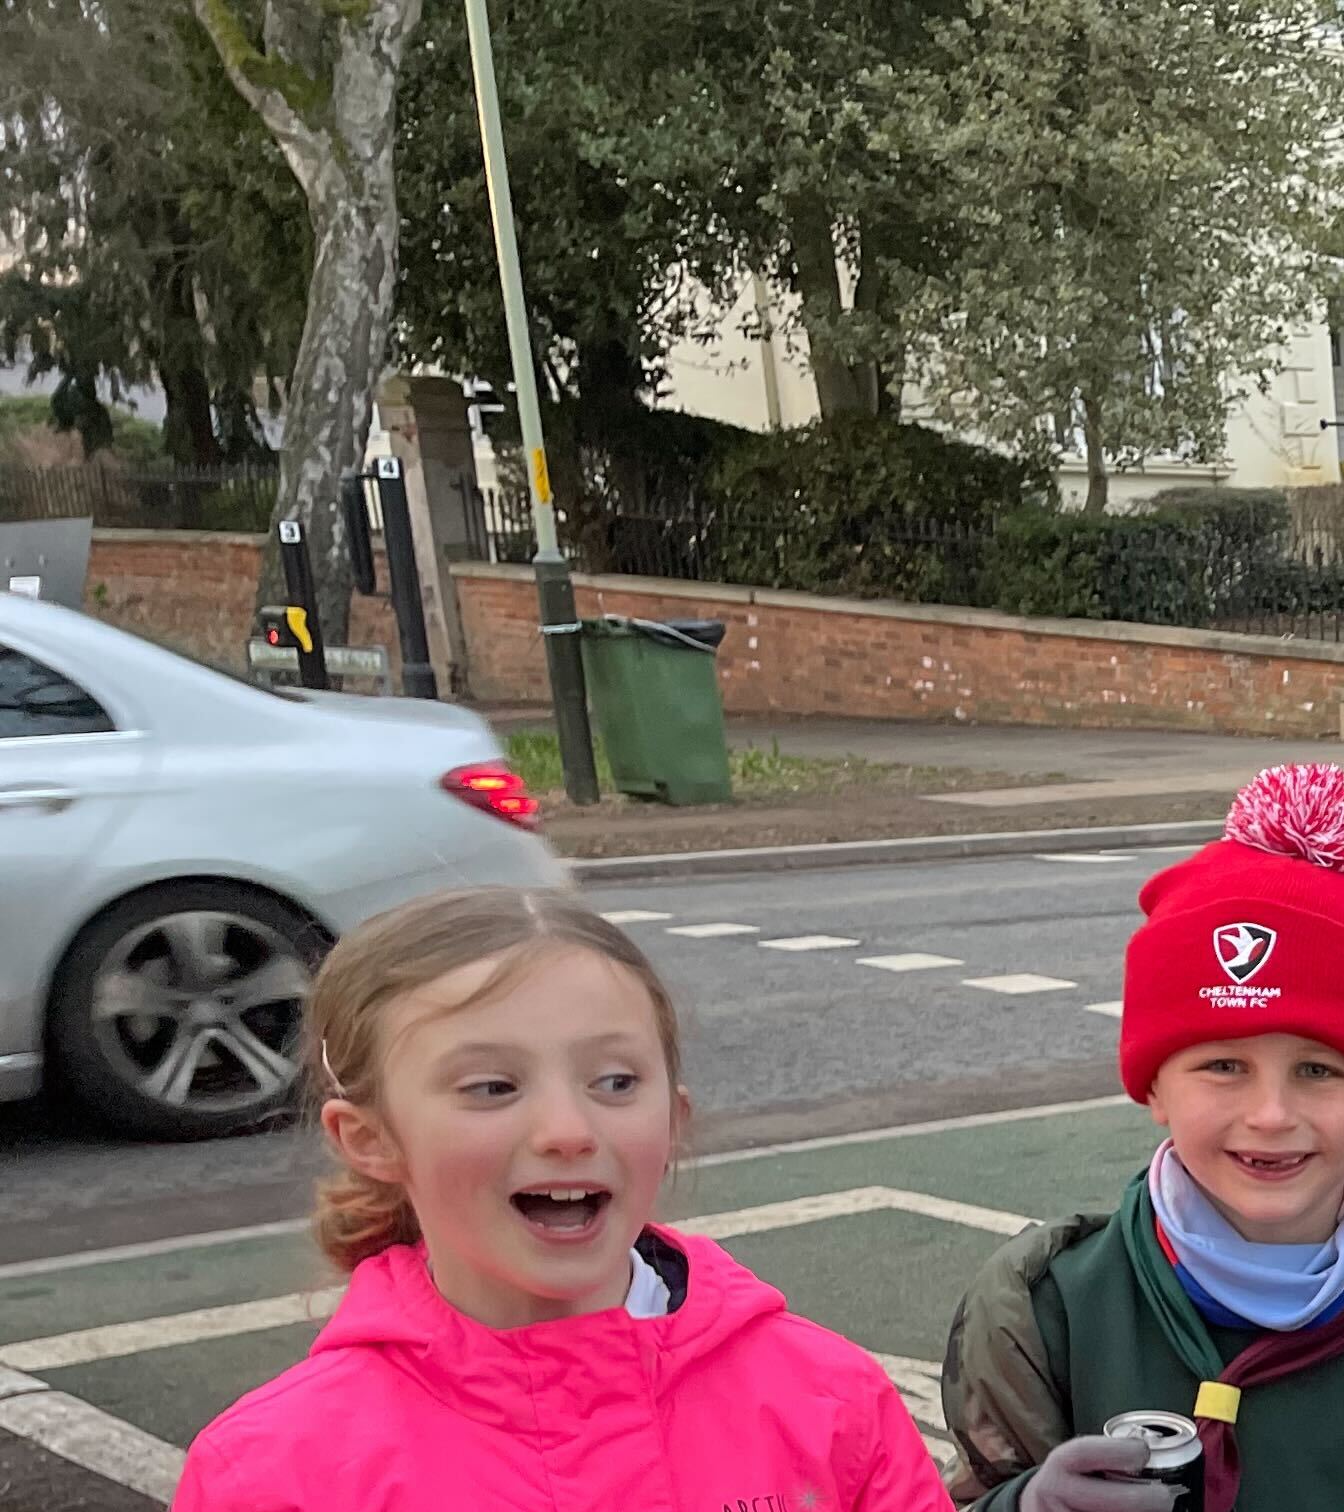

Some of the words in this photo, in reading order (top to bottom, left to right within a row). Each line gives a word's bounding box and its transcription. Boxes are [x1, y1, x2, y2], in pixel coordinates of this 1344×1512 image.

[383, 460, 394, 474] 4
[1199, 985, 1281, 999] CHELTENHAM
[1210, 997, 1247, 1009] TOWN
[1250, 997, 1268, 1009] FC
